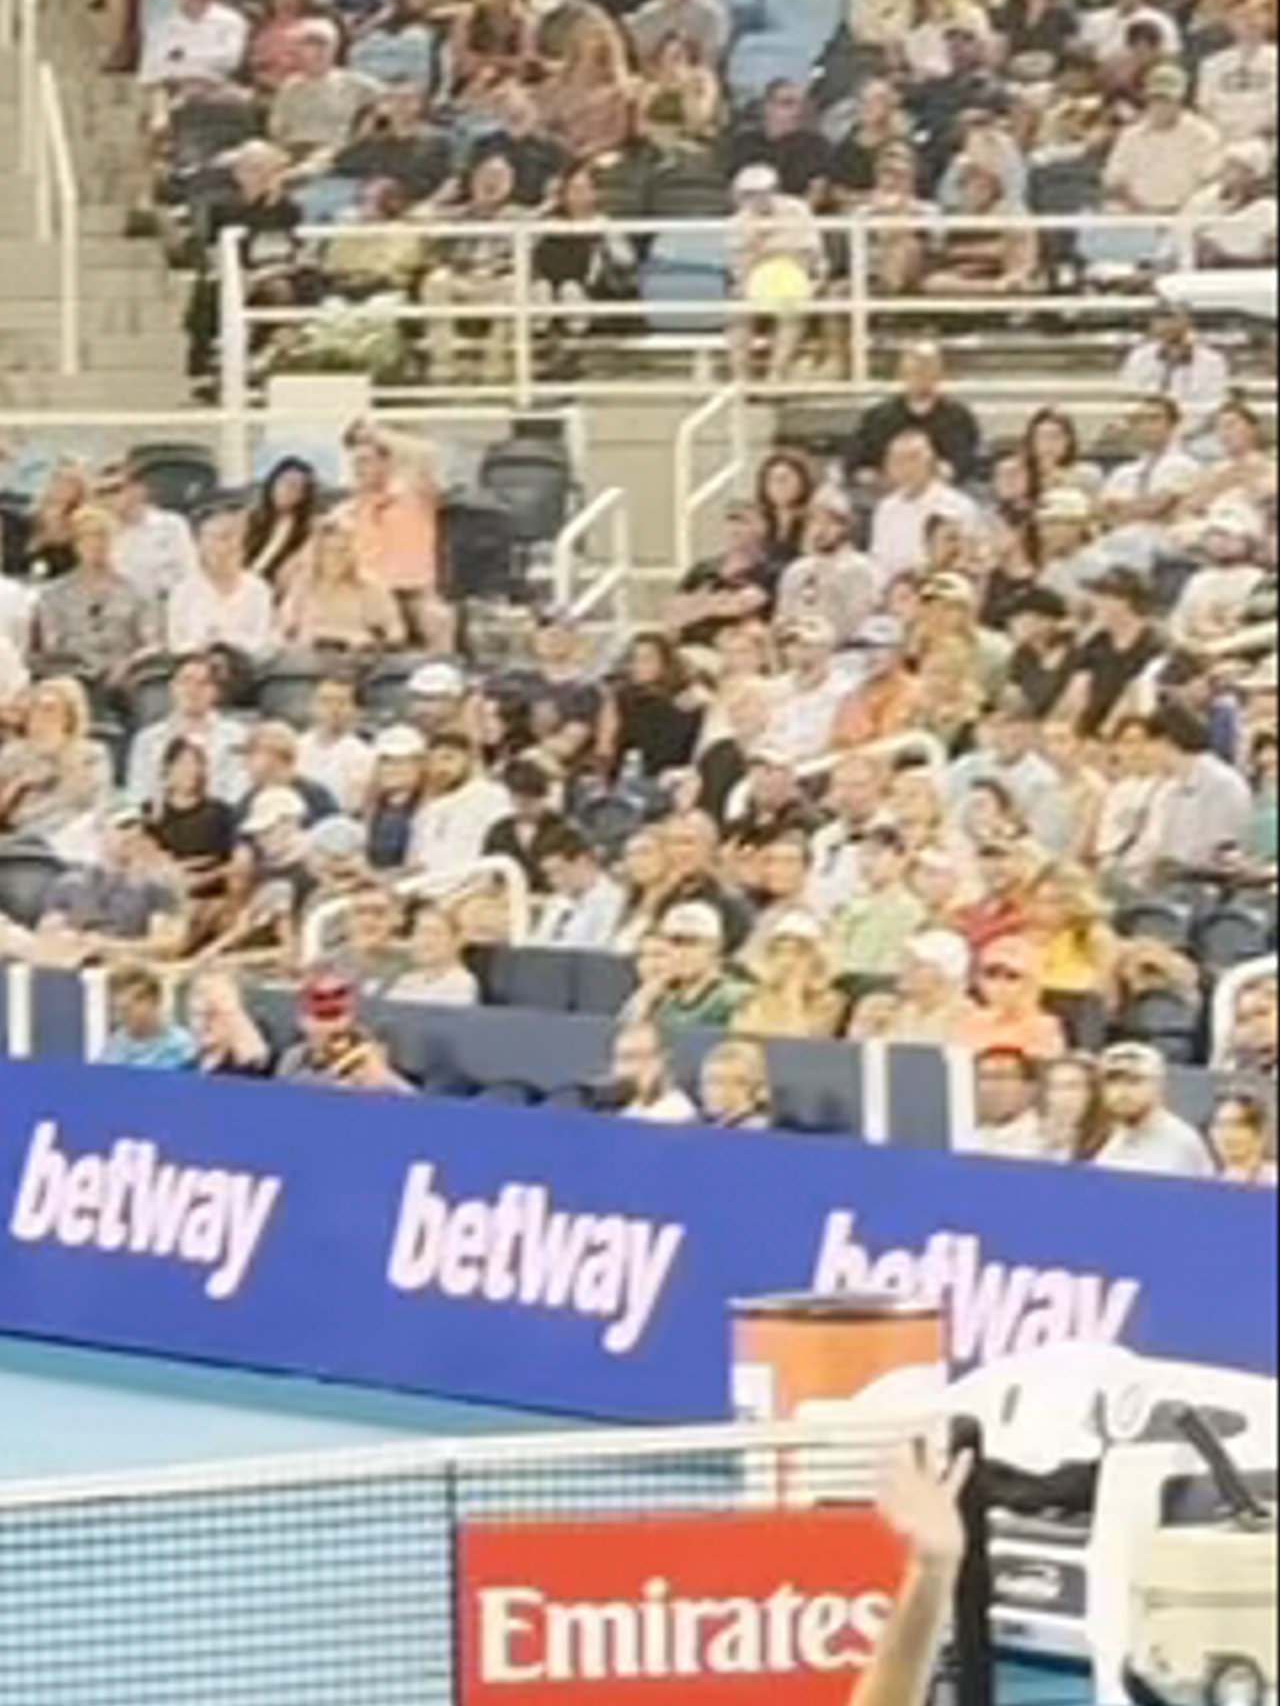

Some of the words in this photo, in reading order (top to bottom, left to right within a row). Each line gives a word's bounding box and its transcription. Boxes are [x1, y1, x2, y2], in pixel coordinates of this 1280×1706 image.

[10, 1121, 281, 1299] betway
[387, 1162, 685, 1353] betway
[477, 1577, 895, 1684] Emirates
